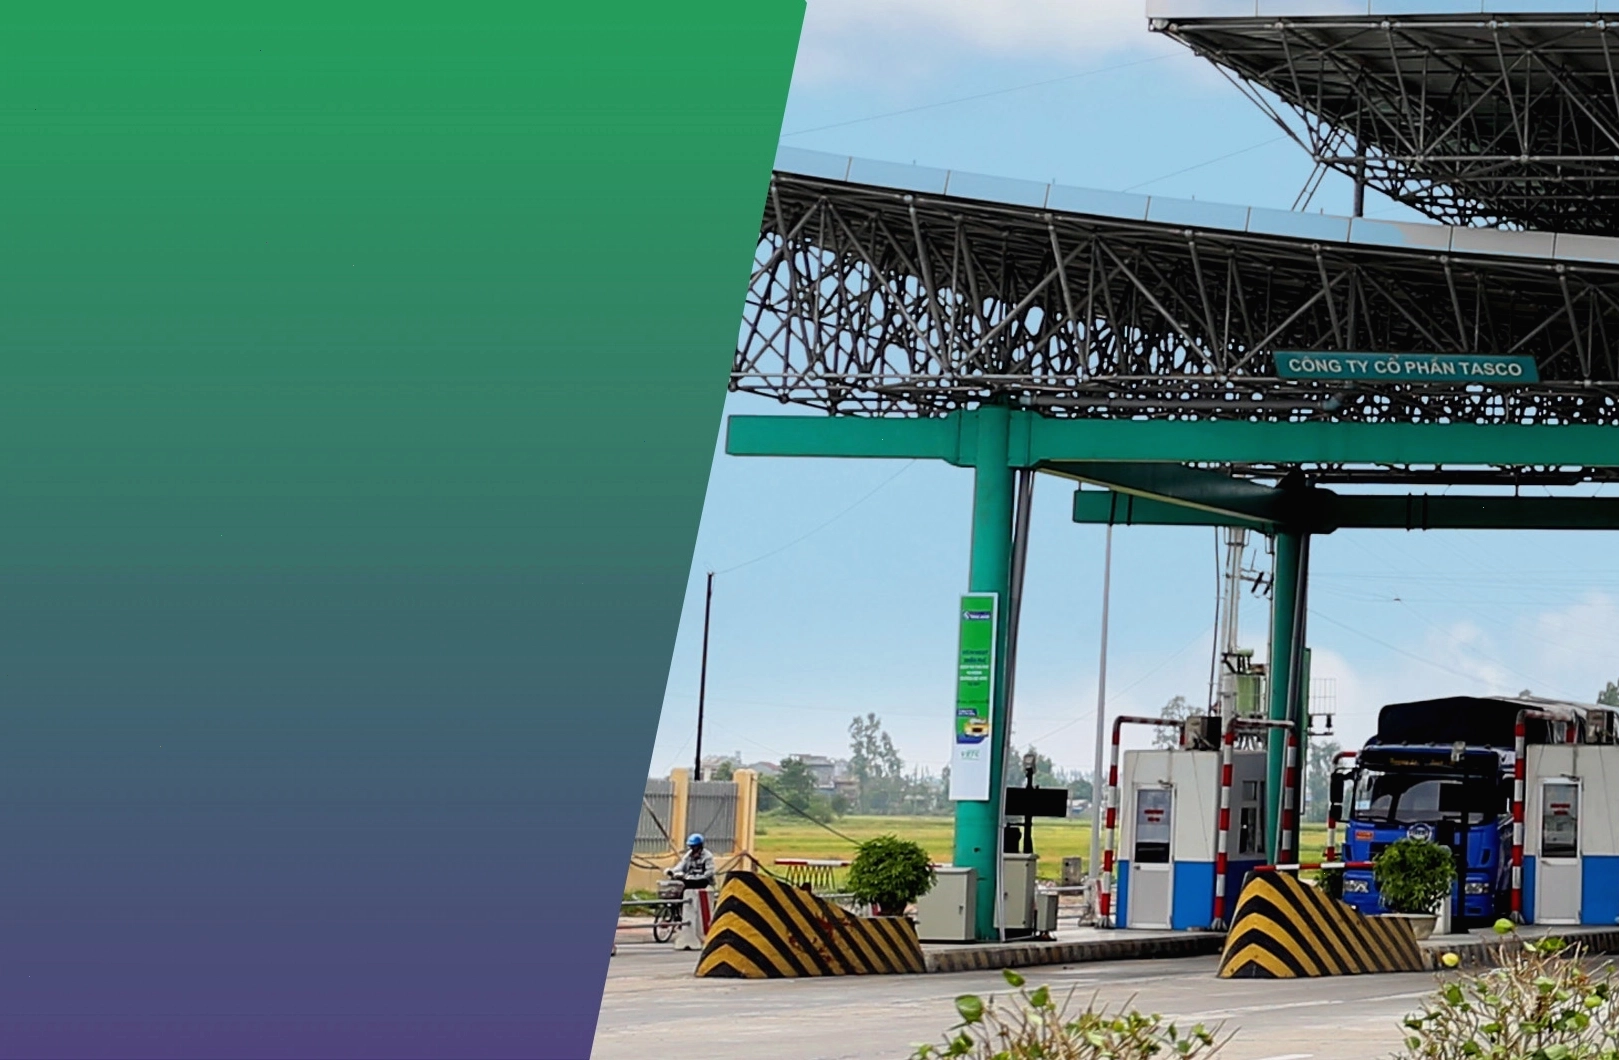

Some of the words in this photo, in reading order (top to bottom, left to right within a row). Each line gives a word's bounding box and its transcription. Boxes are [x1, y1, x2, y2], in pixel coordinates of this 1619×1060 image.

[1288, 356, 1342, 373] CÔNG
[1346, 360, 1368, 373] TY
[1374, 354, 1401, 374] CỔ
[1458, 362, 1522, 377] TASCO
